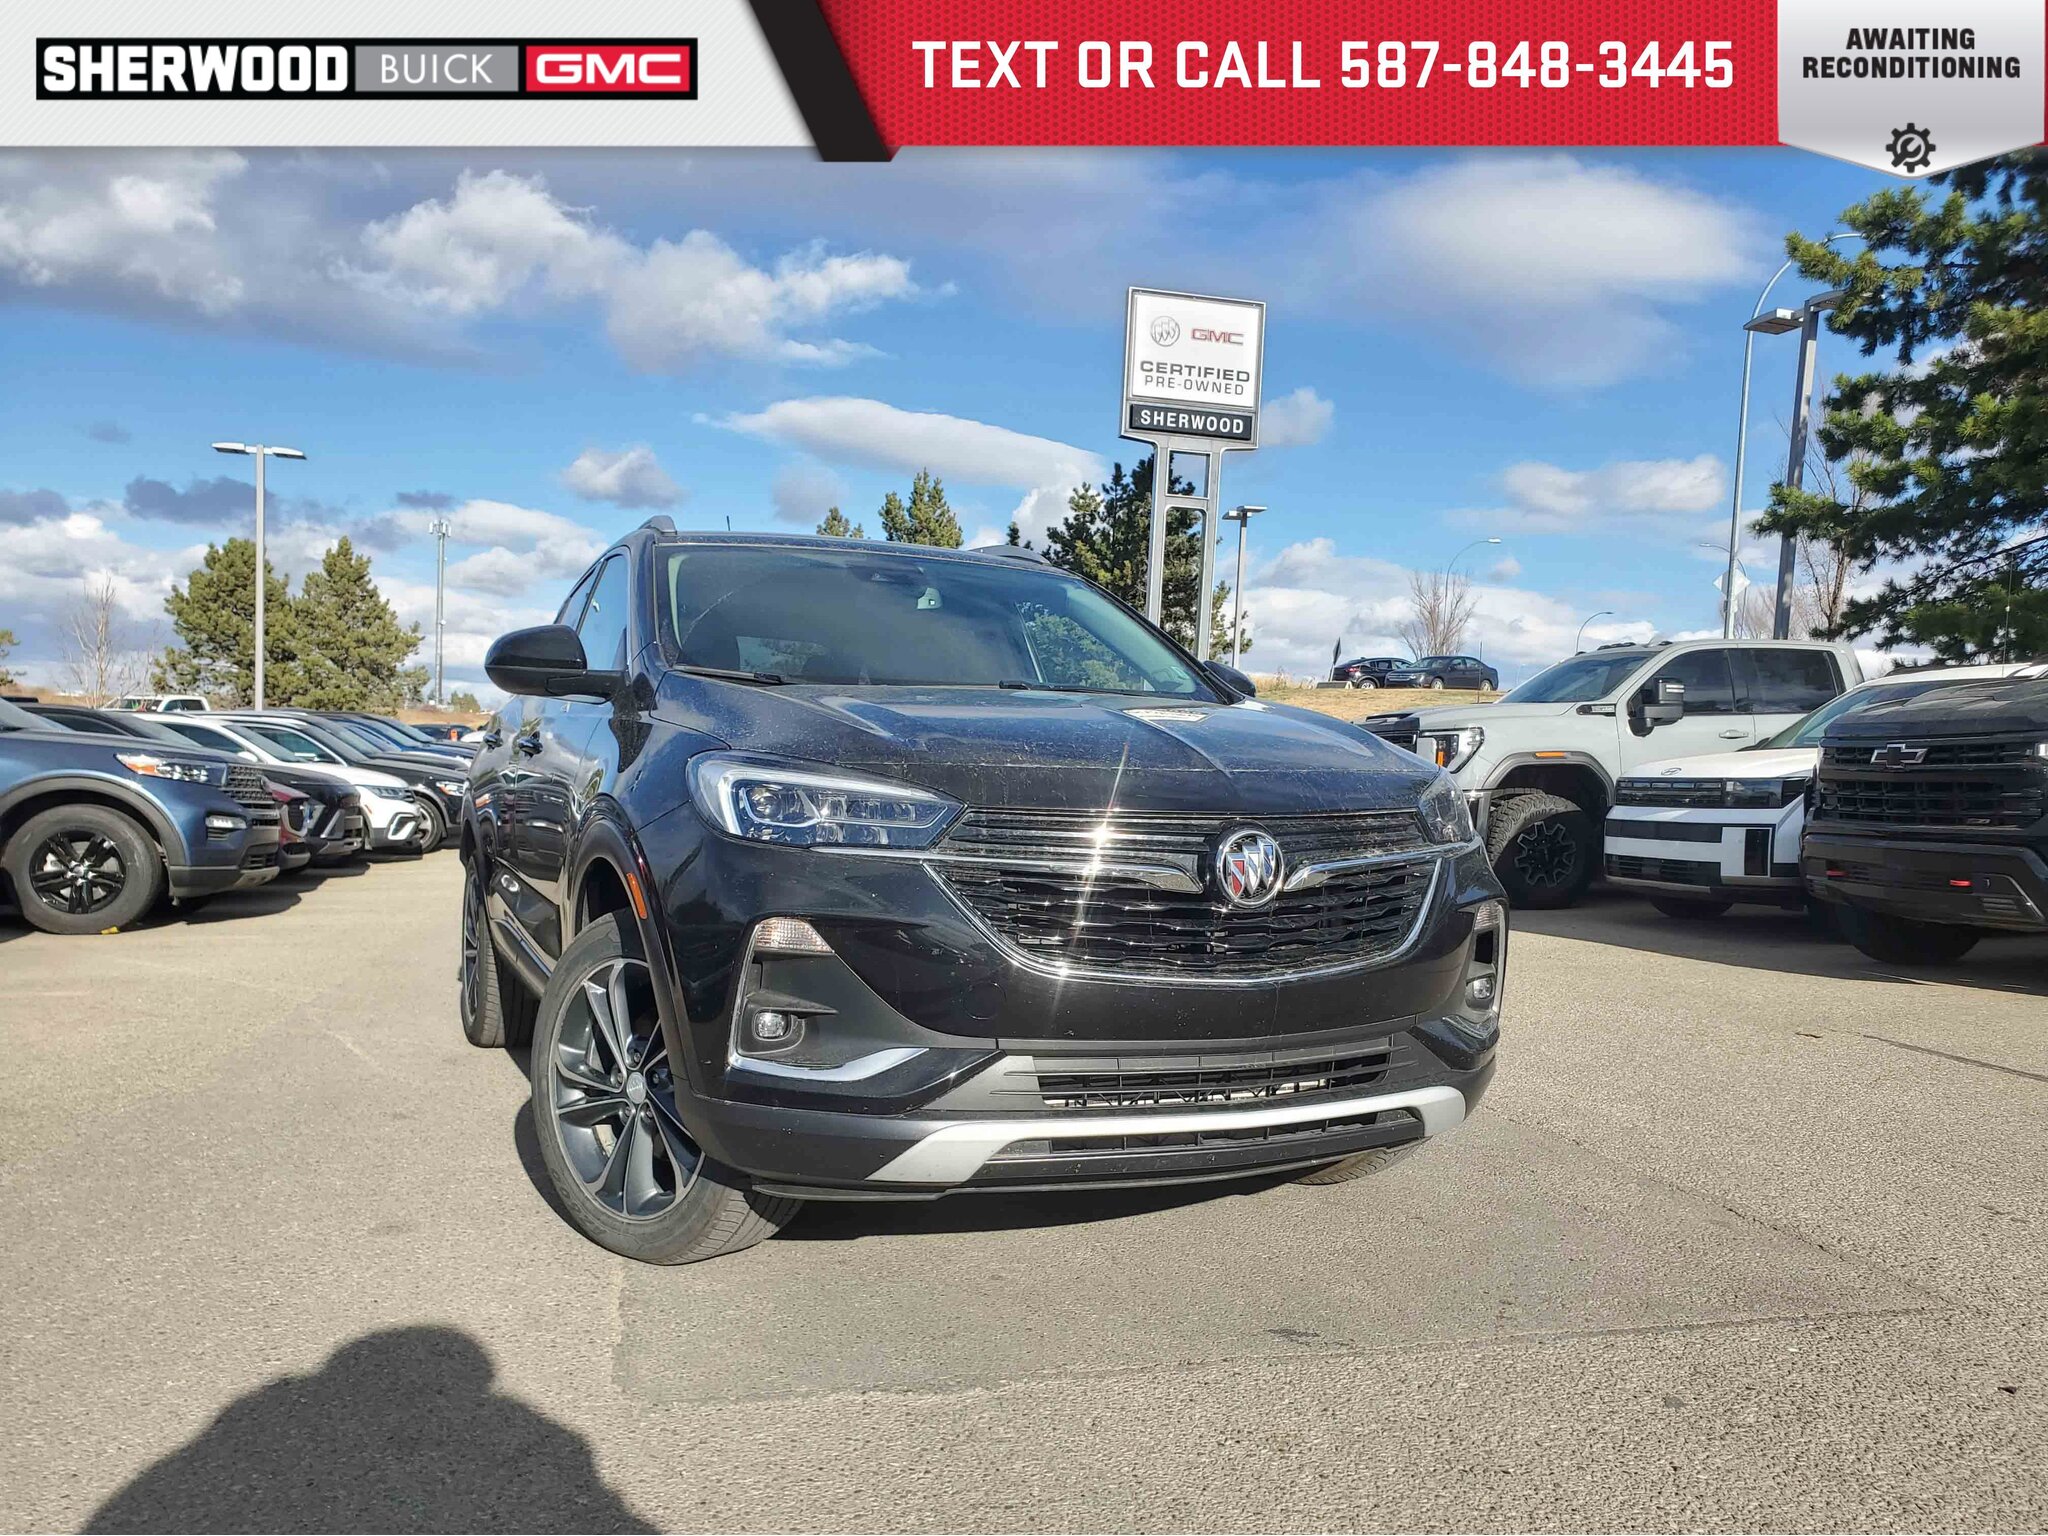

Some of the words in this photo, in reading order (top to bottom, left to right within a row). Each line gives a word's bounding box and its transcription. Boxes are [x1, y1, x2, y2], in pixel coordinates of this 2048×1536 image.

[1191, 328, 1244, 346] GMC
[1140, 360, 1250, 382] CERTIFIED
[1144, 374, 1244, 396] PRE-OWNED
[1140, 409, 1244, 434] SHERWOOD
